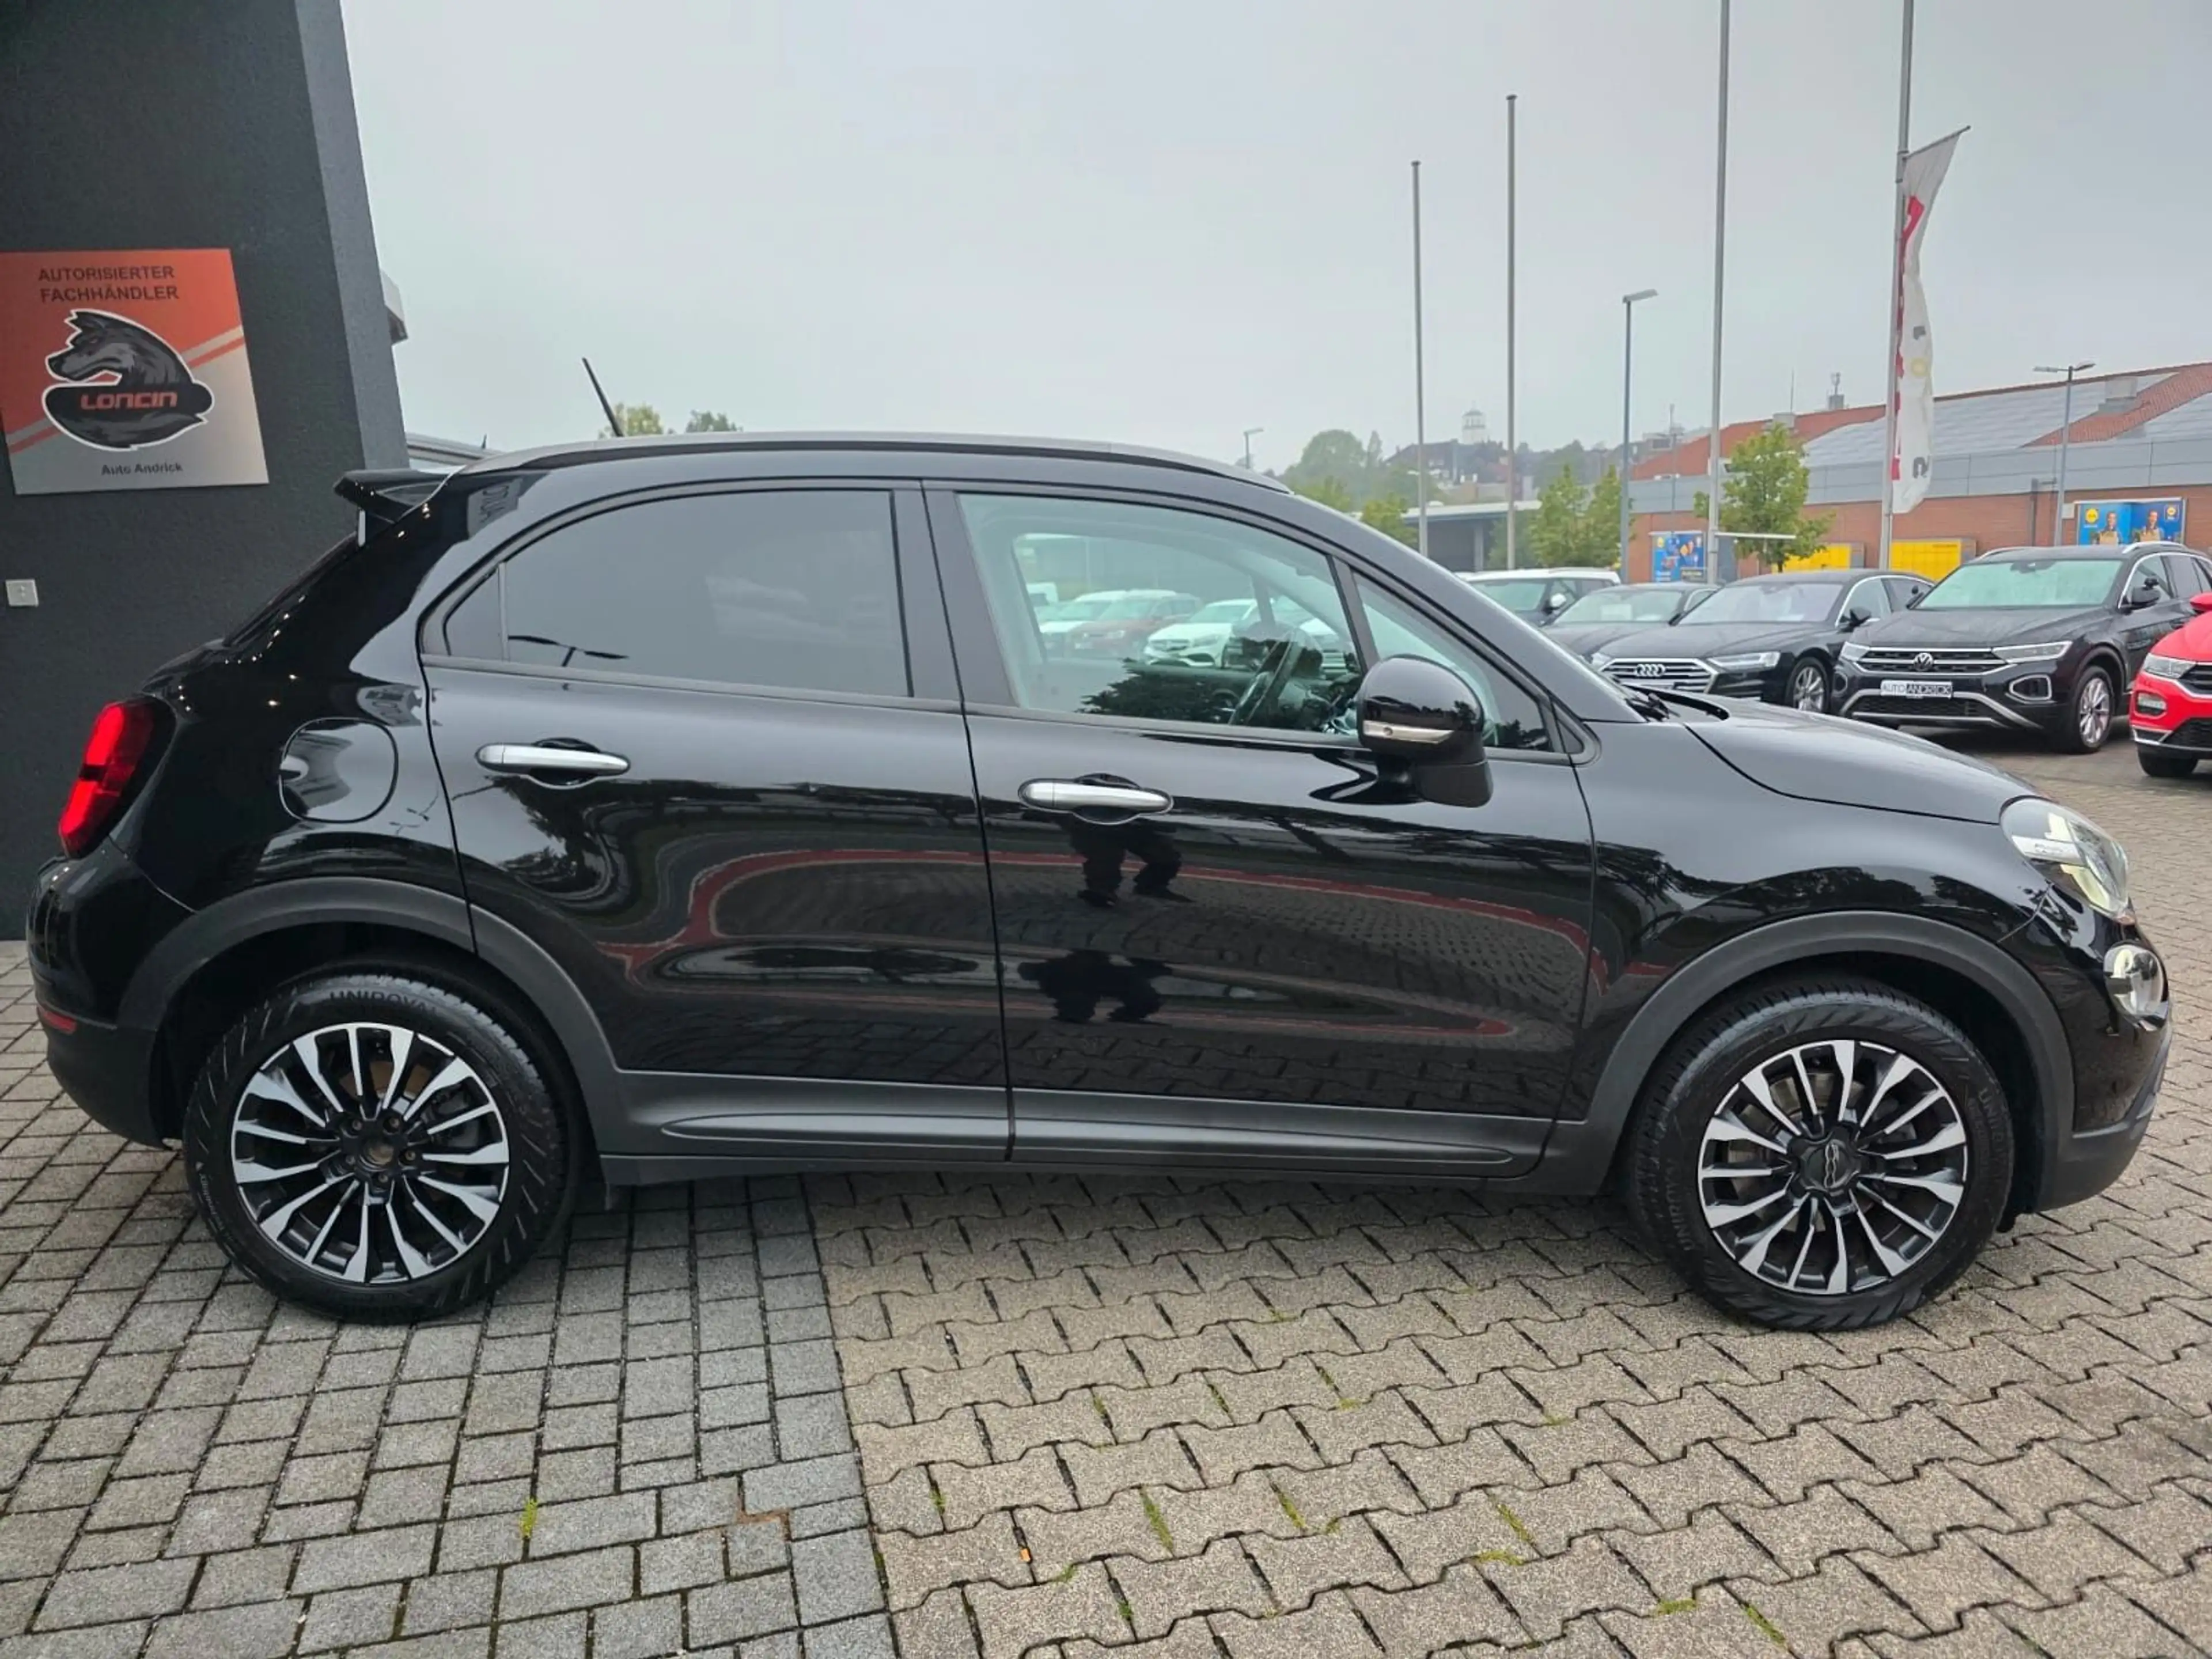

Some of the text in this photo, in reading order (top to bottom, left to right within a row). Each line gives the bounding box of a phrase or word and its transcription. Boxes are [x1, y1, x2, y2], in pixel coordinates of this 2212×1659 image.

[38, 265, 175, 282] AUTORISIERTER
[40, 285, 180, 304] FACHHÄNDLER
[101, 462, 183, 476] Auto Andrick
